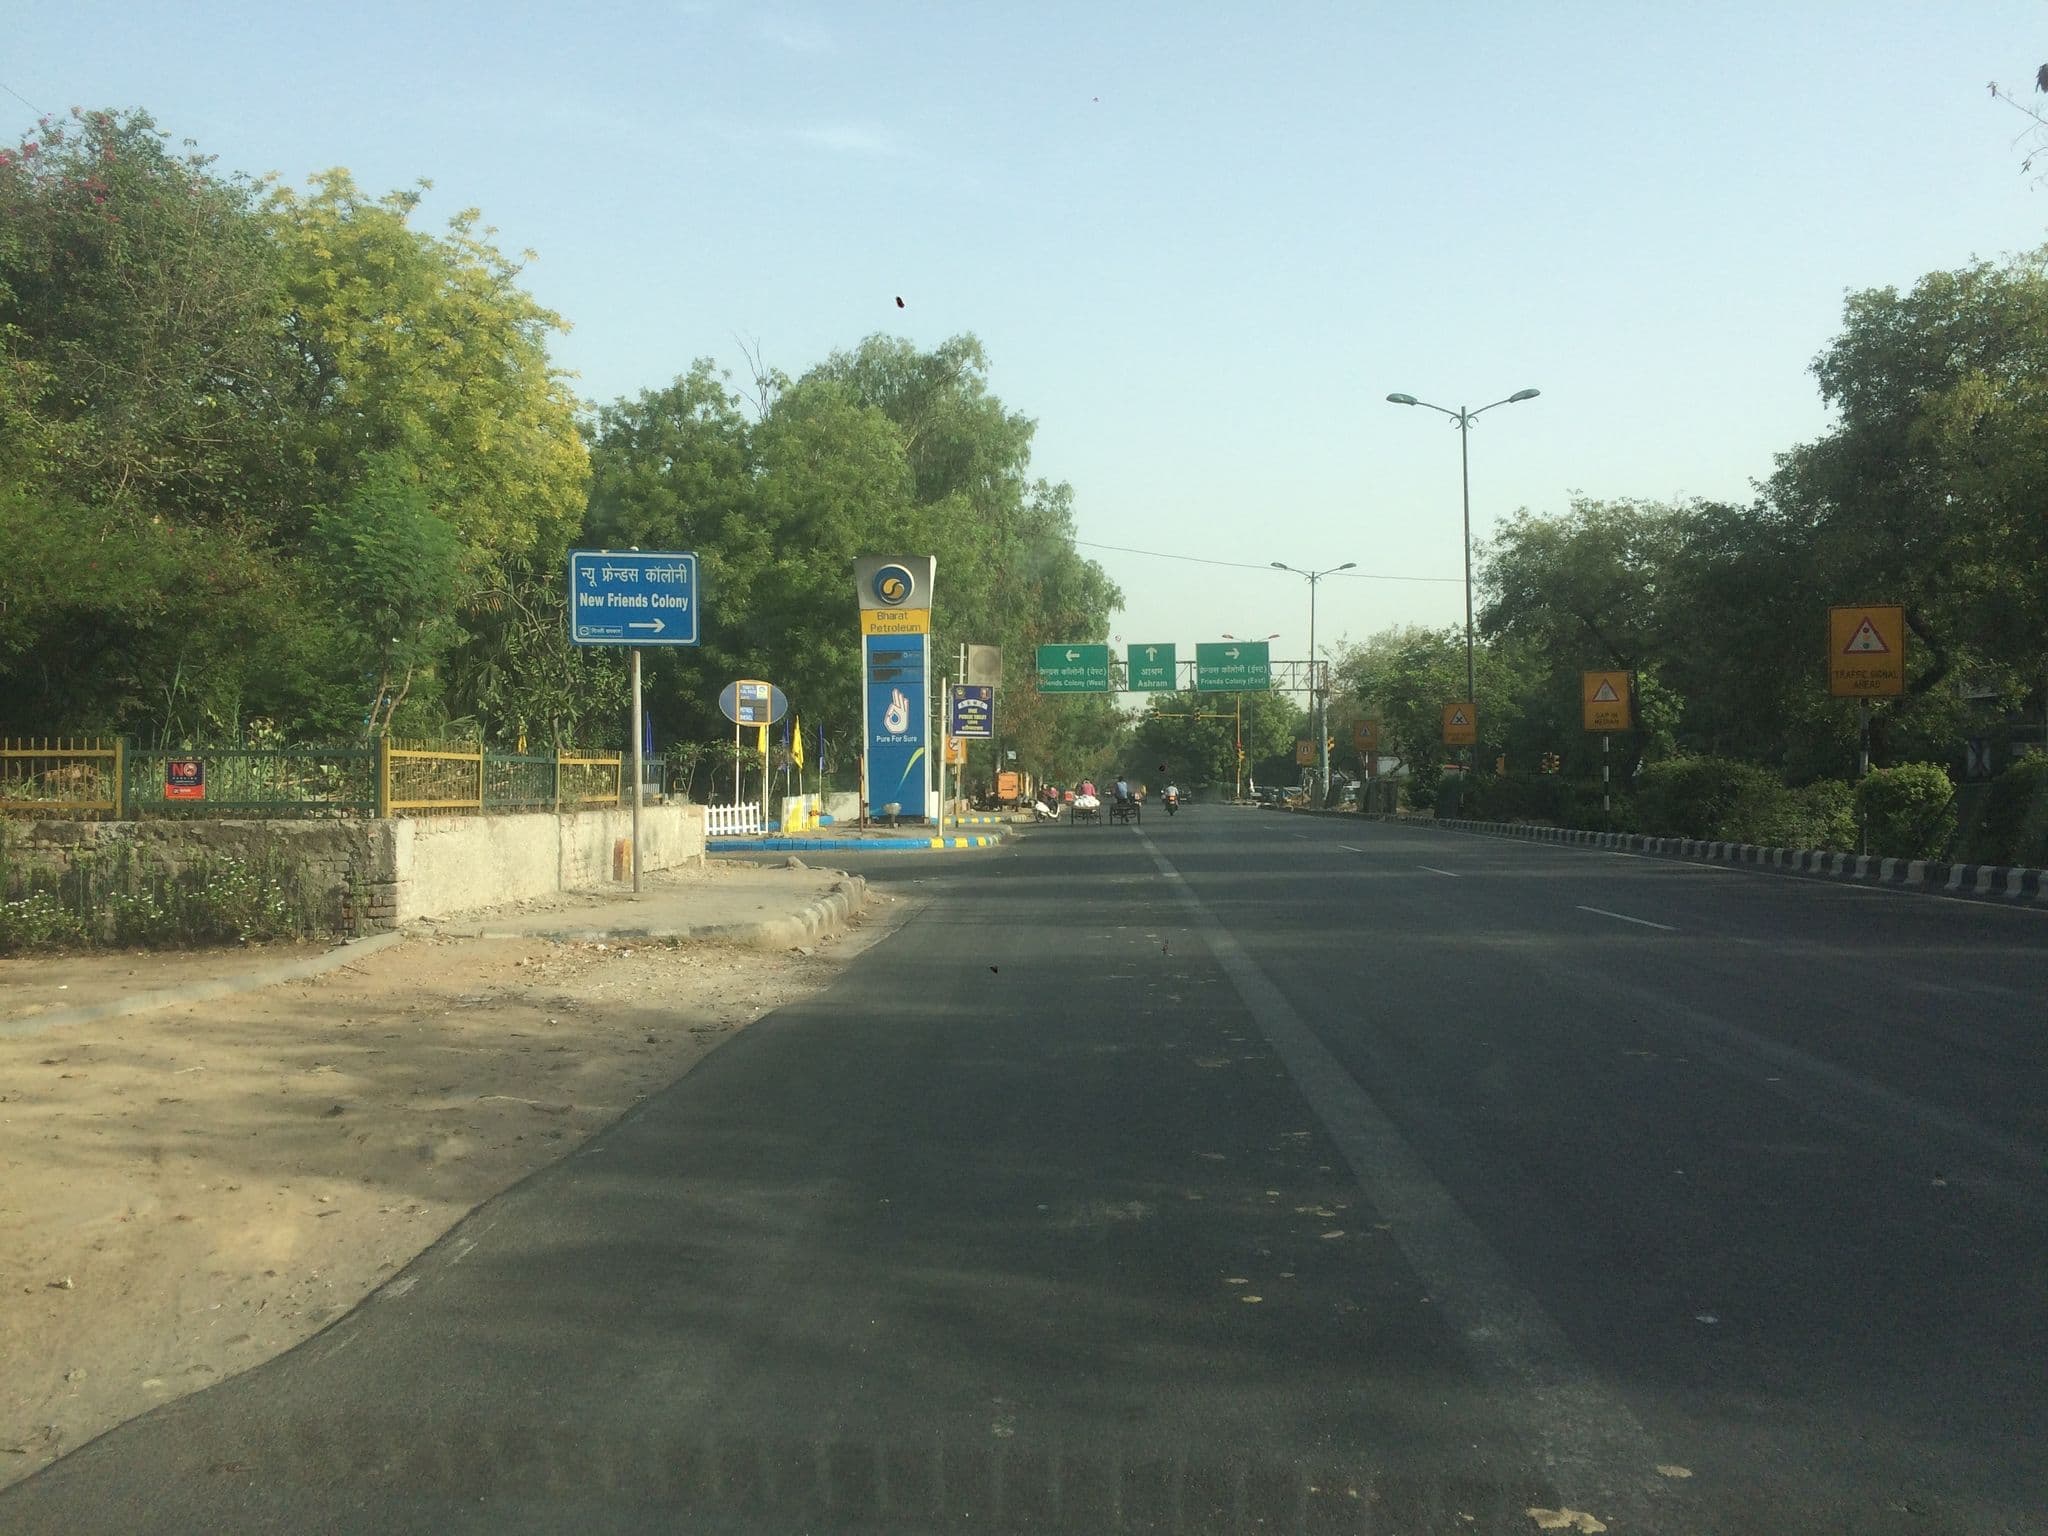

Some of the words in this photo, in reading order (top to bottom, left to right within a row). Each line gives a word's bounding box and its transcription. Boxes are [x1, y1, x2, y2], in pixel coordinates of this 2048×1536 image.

[580, 567, 597, 587] न्यू
[645, 563, 687, 584] कॉलोनी
[580, 592, 604, 607] New
[607, 592, 648, 608] Friends
[651, 593, 688, 612] Colony
[877, 612, 908, 621] Bharat
[870, 623, 921, 633] Petroleum
[1137, 679, 1168, 688] Ashram
[1200, 678, 1224, 686] Friends
[1225, 678, 1246, 687] Colony
[876, 735, 890, 743] Pure
[891, 735, 903, 743] For
[903, 735, 917, 743] Sure
